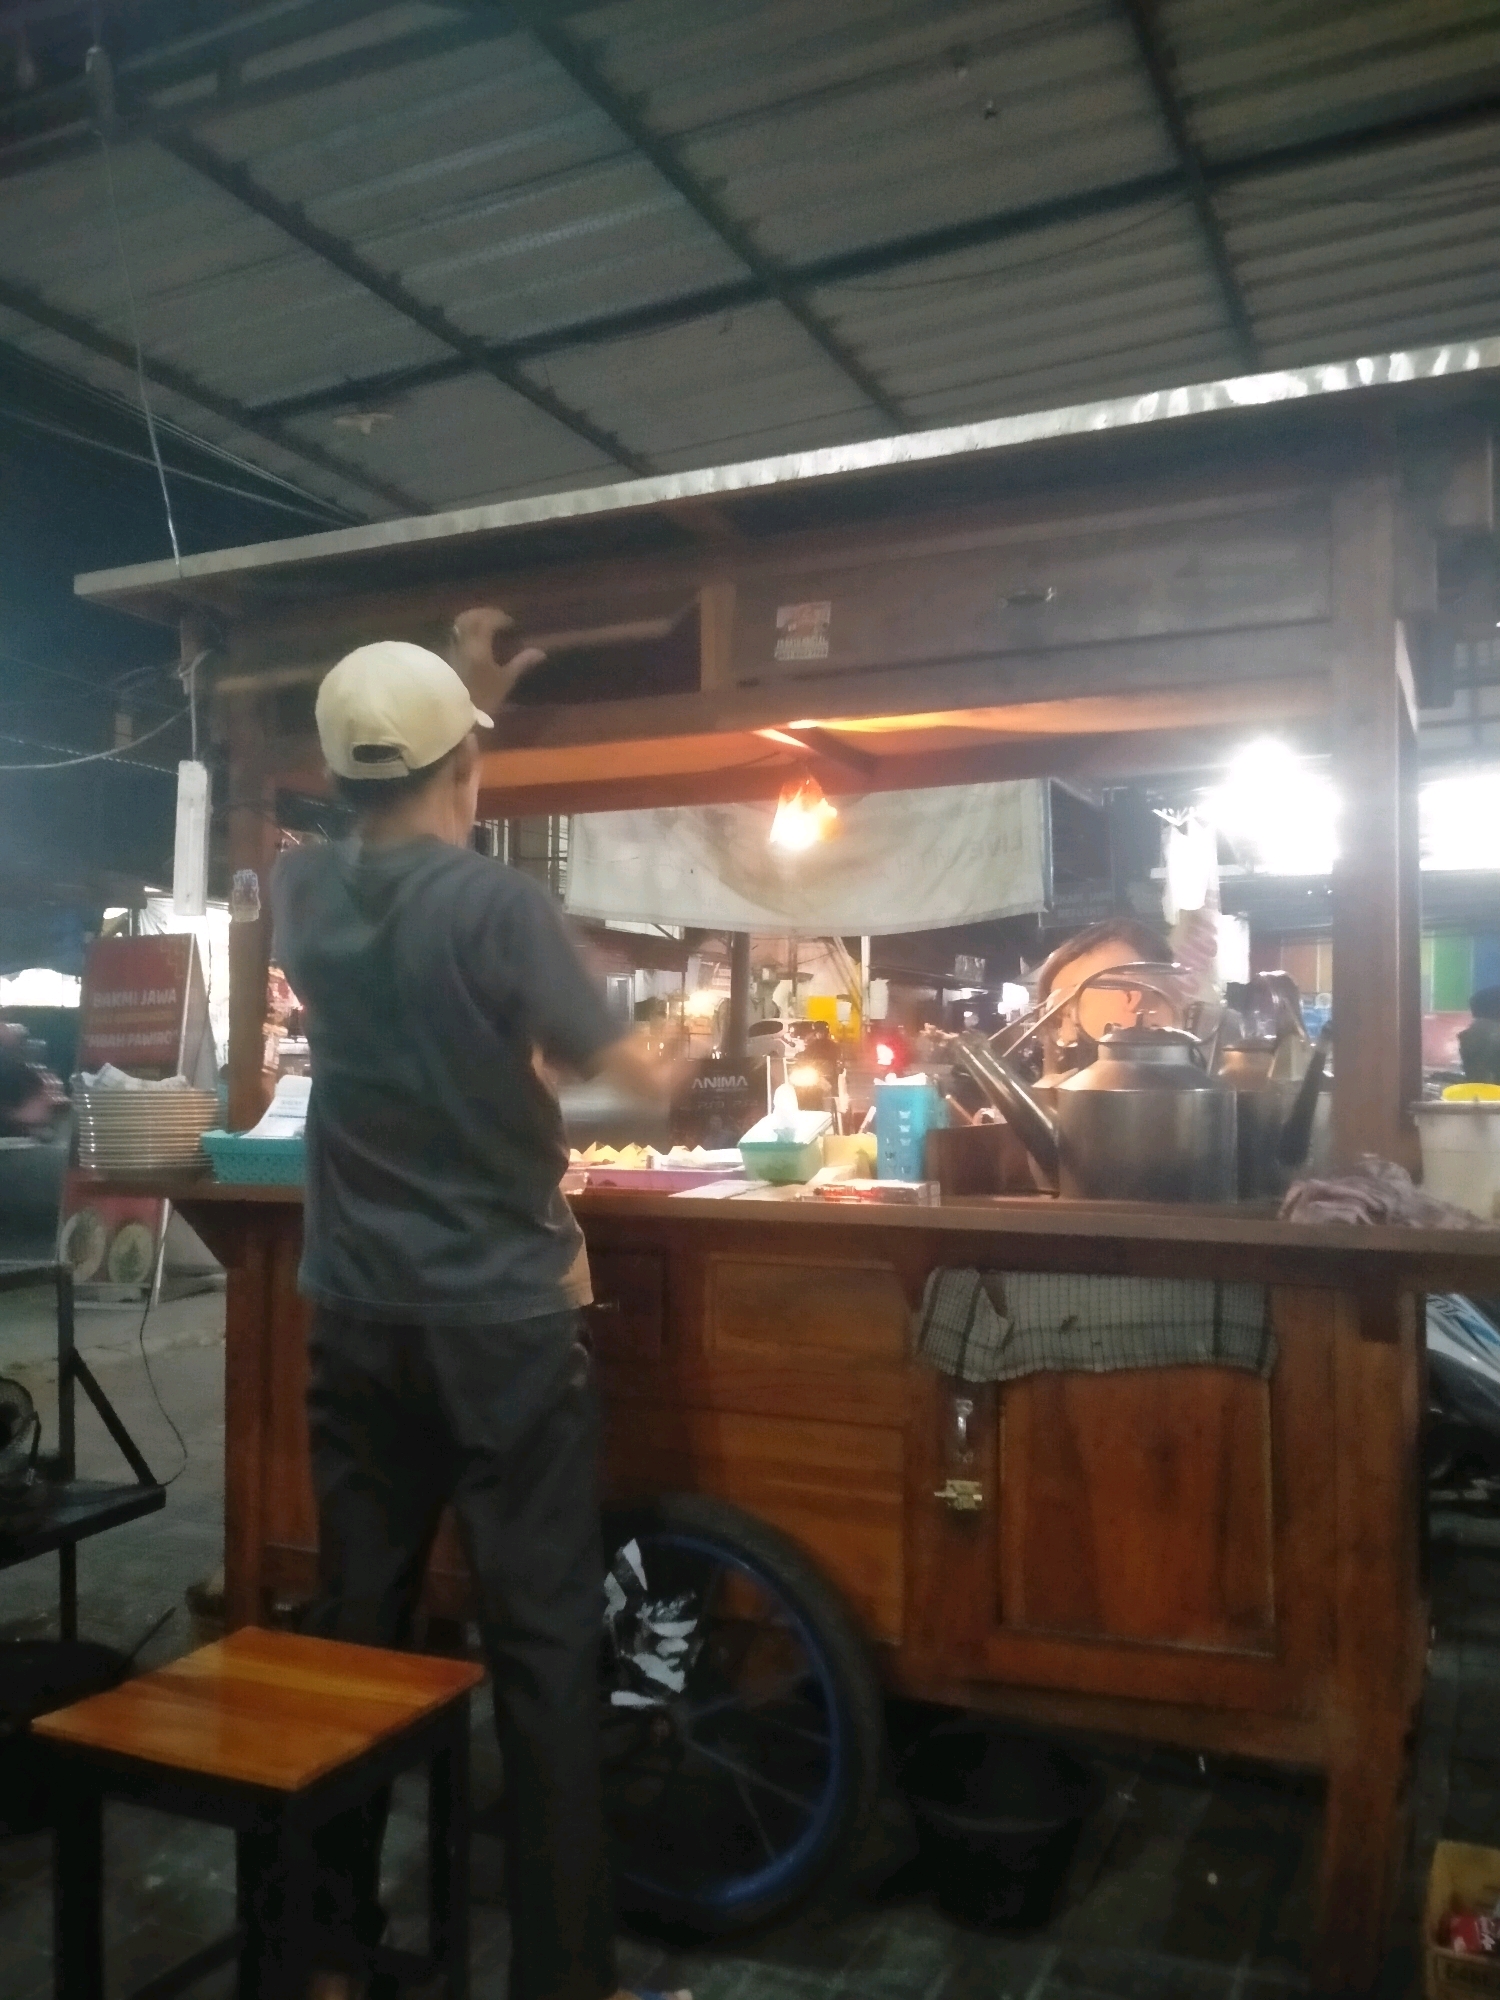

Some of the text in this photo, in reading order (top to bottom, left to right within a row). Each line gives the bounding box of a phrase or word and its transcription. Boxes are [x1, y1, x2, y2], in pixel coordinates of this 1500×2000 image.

[93, 987, 177, 1009] BAKMI JAWA
[691, 1075, 748, 1089] ANIMA
